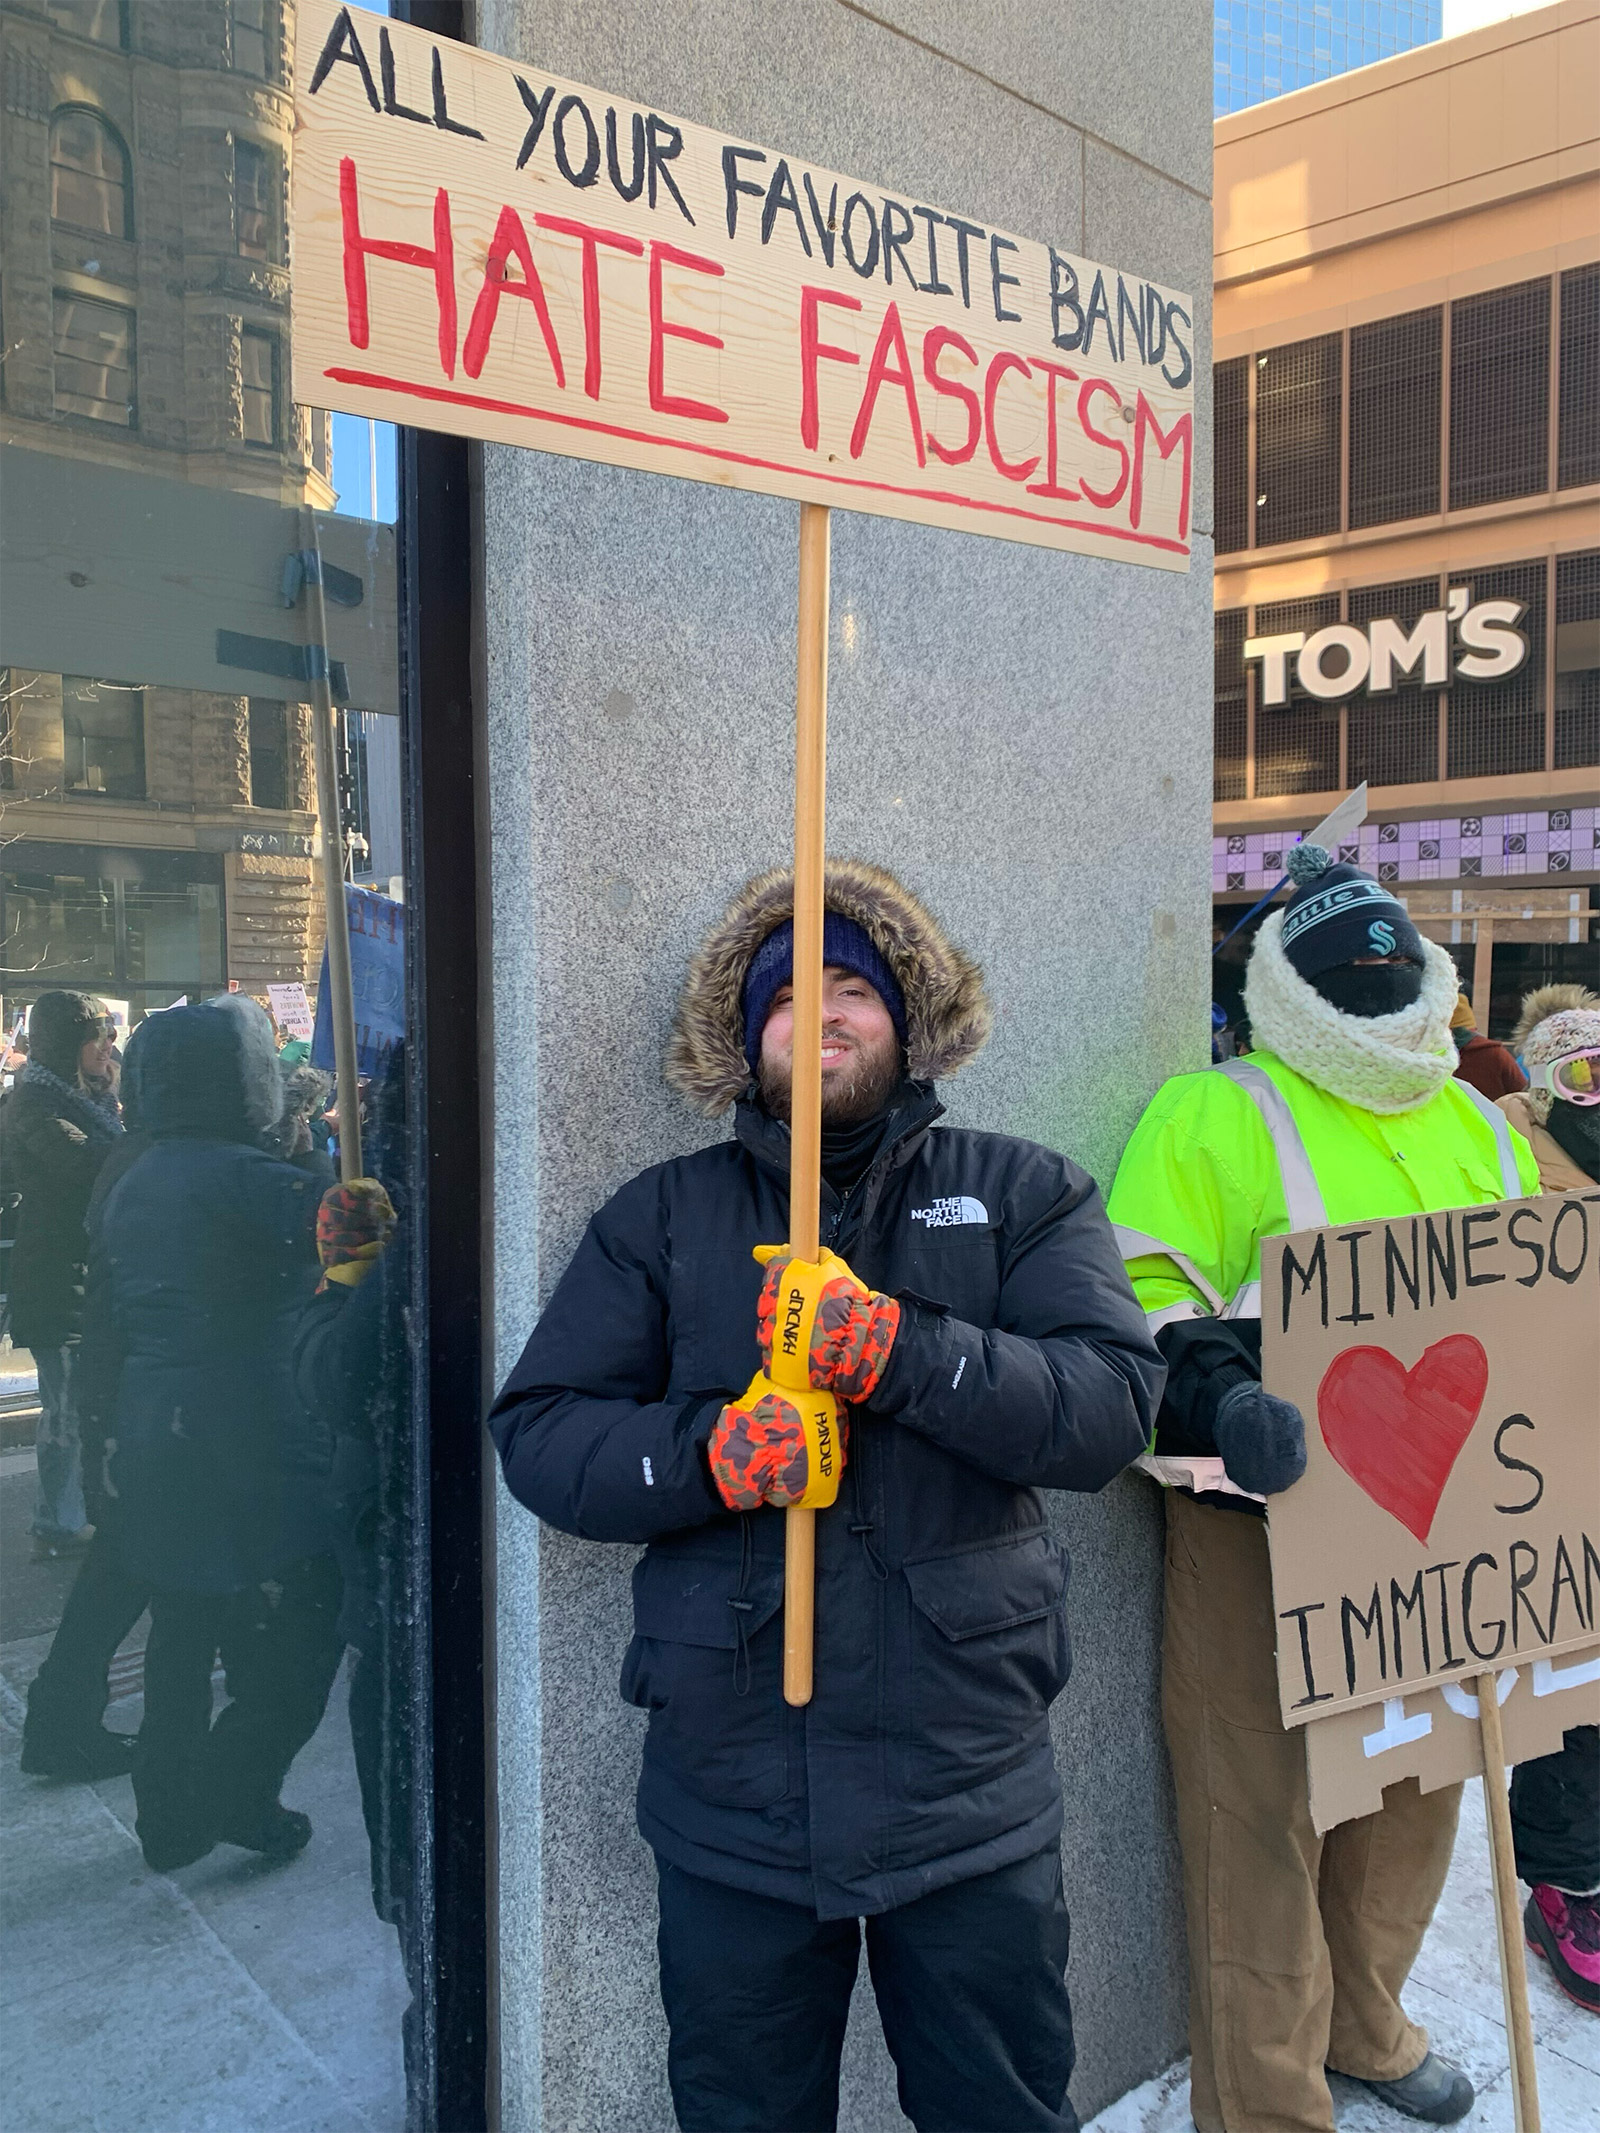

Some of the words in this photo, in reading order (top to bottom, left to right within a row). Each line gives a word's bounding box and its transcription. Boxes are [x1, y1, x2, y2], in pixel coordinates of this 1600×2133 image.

[309, 6, 487, 141] ALL
[511, 72, 696, 227] YOUR
[721, 145, 1023, 323] FAVORITE
[1048, 245, 1193, 390] BANDS
[339, 155, 729, 424] HATE
[801, 285, 1192, 541] FASCISM
[1244, 587, 1526, 706] TOM'S
[911, 1206, 960, 1220] NORTH
[926, 1215, 962, 1228] FACE
[932, 1197, 961, 1208] THE
[783, 1288, 805, 1356] HANDUP
[814, 1411, 832, 1477] HANDUP
[1494, 1413, 1544, 1514] S
